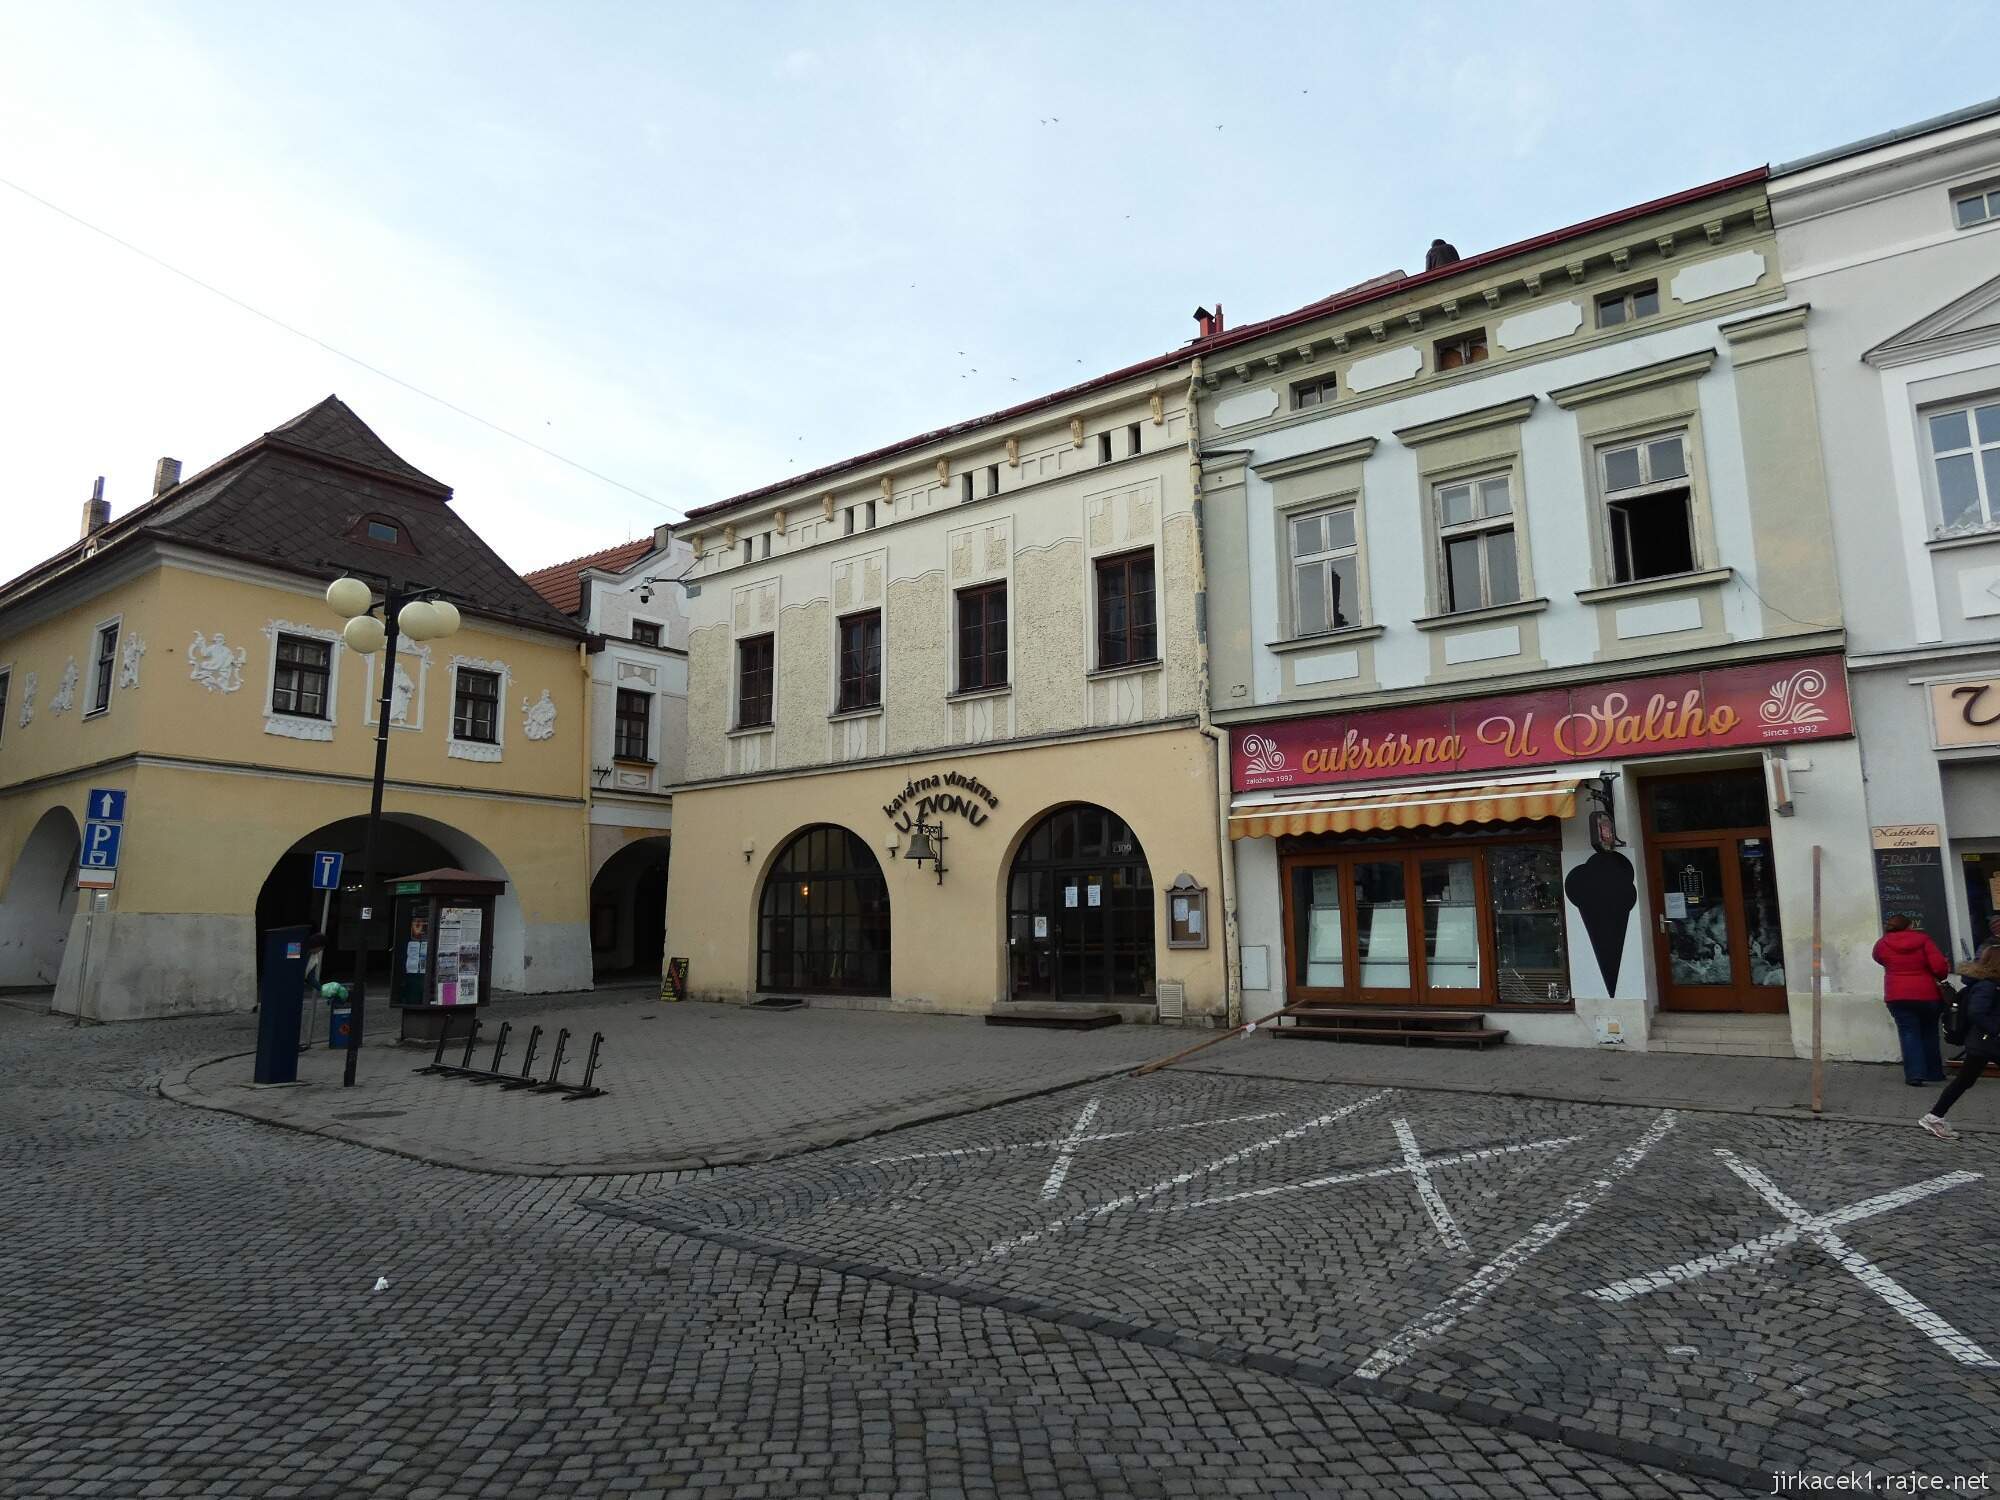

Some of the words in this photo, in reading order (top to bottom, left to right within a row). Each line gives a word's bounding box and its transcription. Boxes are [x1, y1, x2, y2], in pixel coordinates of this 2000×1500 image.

[1302, 721, 1465, 775] cukrárna
[1476, 712, 1537, 758] U
[1554, 690, 1740, 757] Saliho
[1762, 728, 1789, 738] since
[1792, 725, 1819, 735] 1992
[1246, 777, 1275, 785] založeno
[1276, 774, 1293, 782] 1992
[882, 774, 941, 819] kavárna
[943, 771, 999, 809] vinárna
[894, 810, 913, 834] U
[915, 793, 990, 828] ZVONU
[93, 825, 112, 851] P
[1893, 838, 1918, 847] dne
